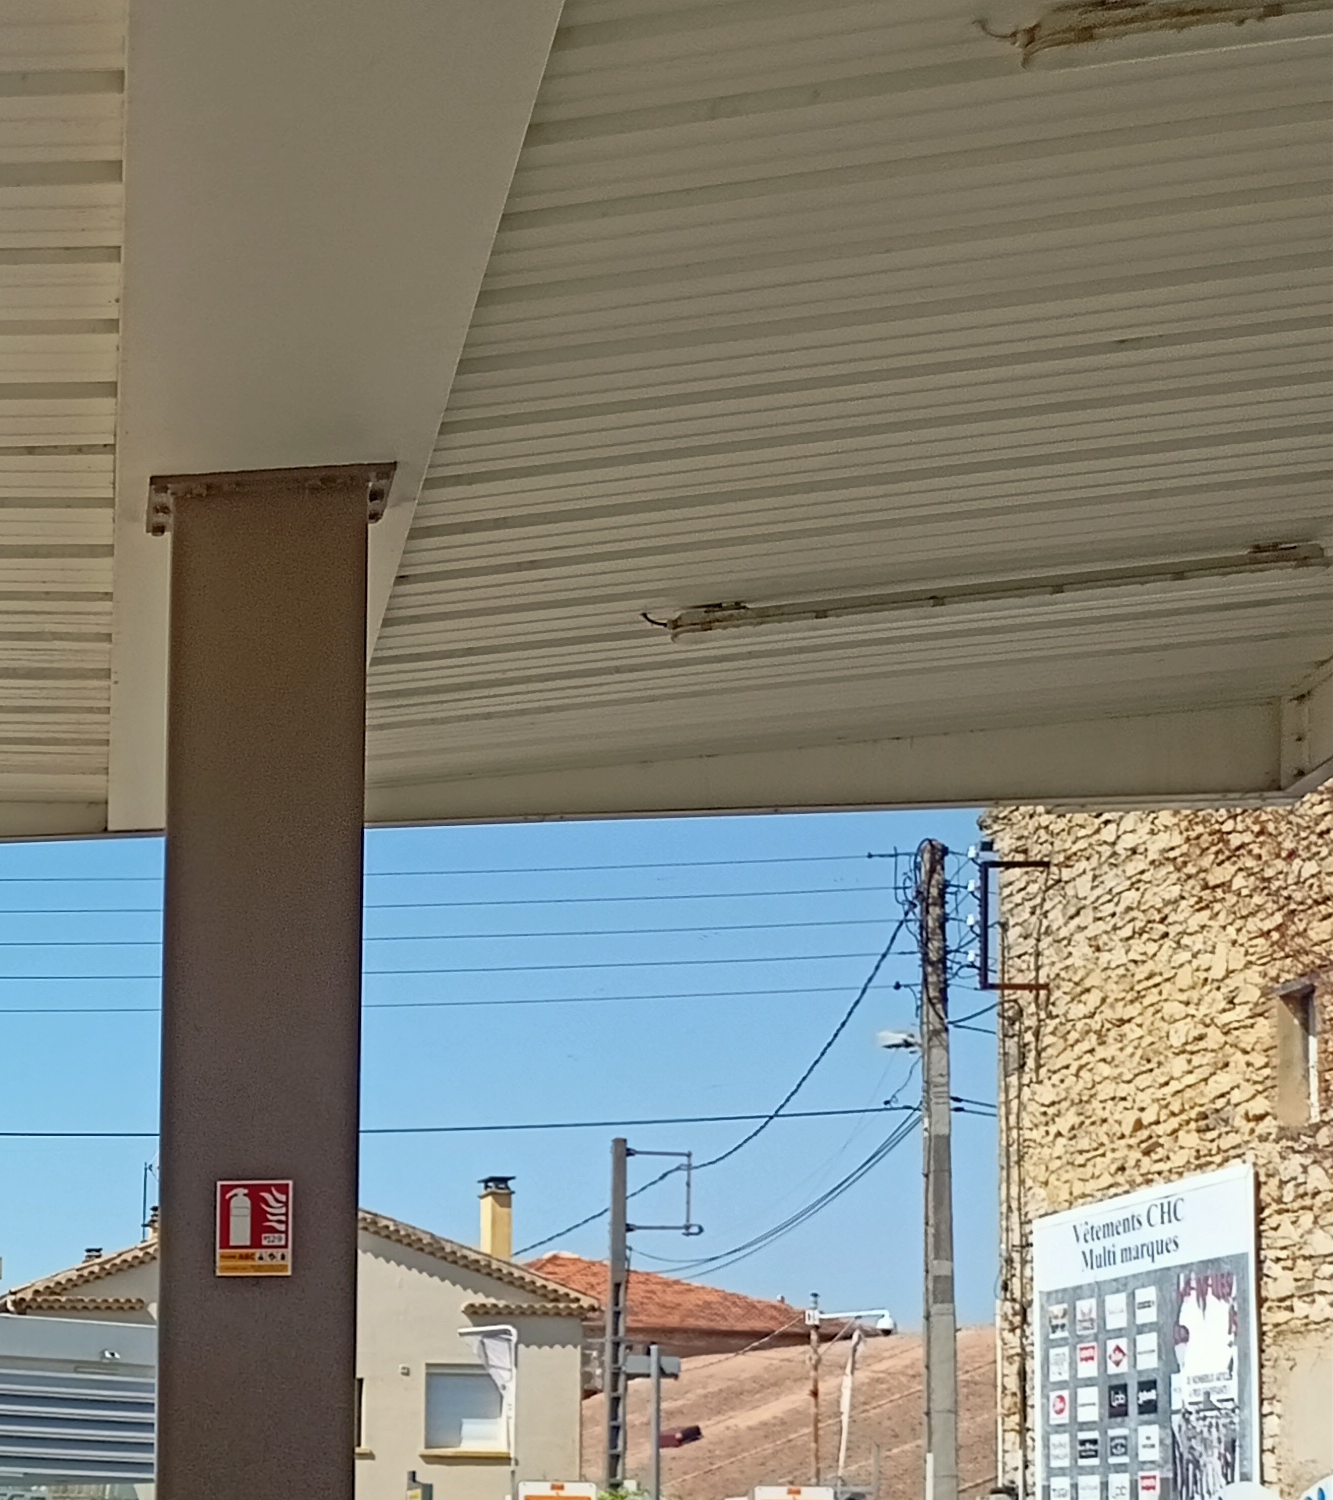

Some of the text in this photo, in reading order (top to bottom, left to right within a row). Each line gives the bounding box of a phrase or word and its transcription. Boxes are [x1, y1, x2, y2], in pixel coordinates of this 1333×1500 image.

[1072, 1197, 1185, 1244] Vêtements CHC
[1080, 1235, 1180, 1271] Multi marques
